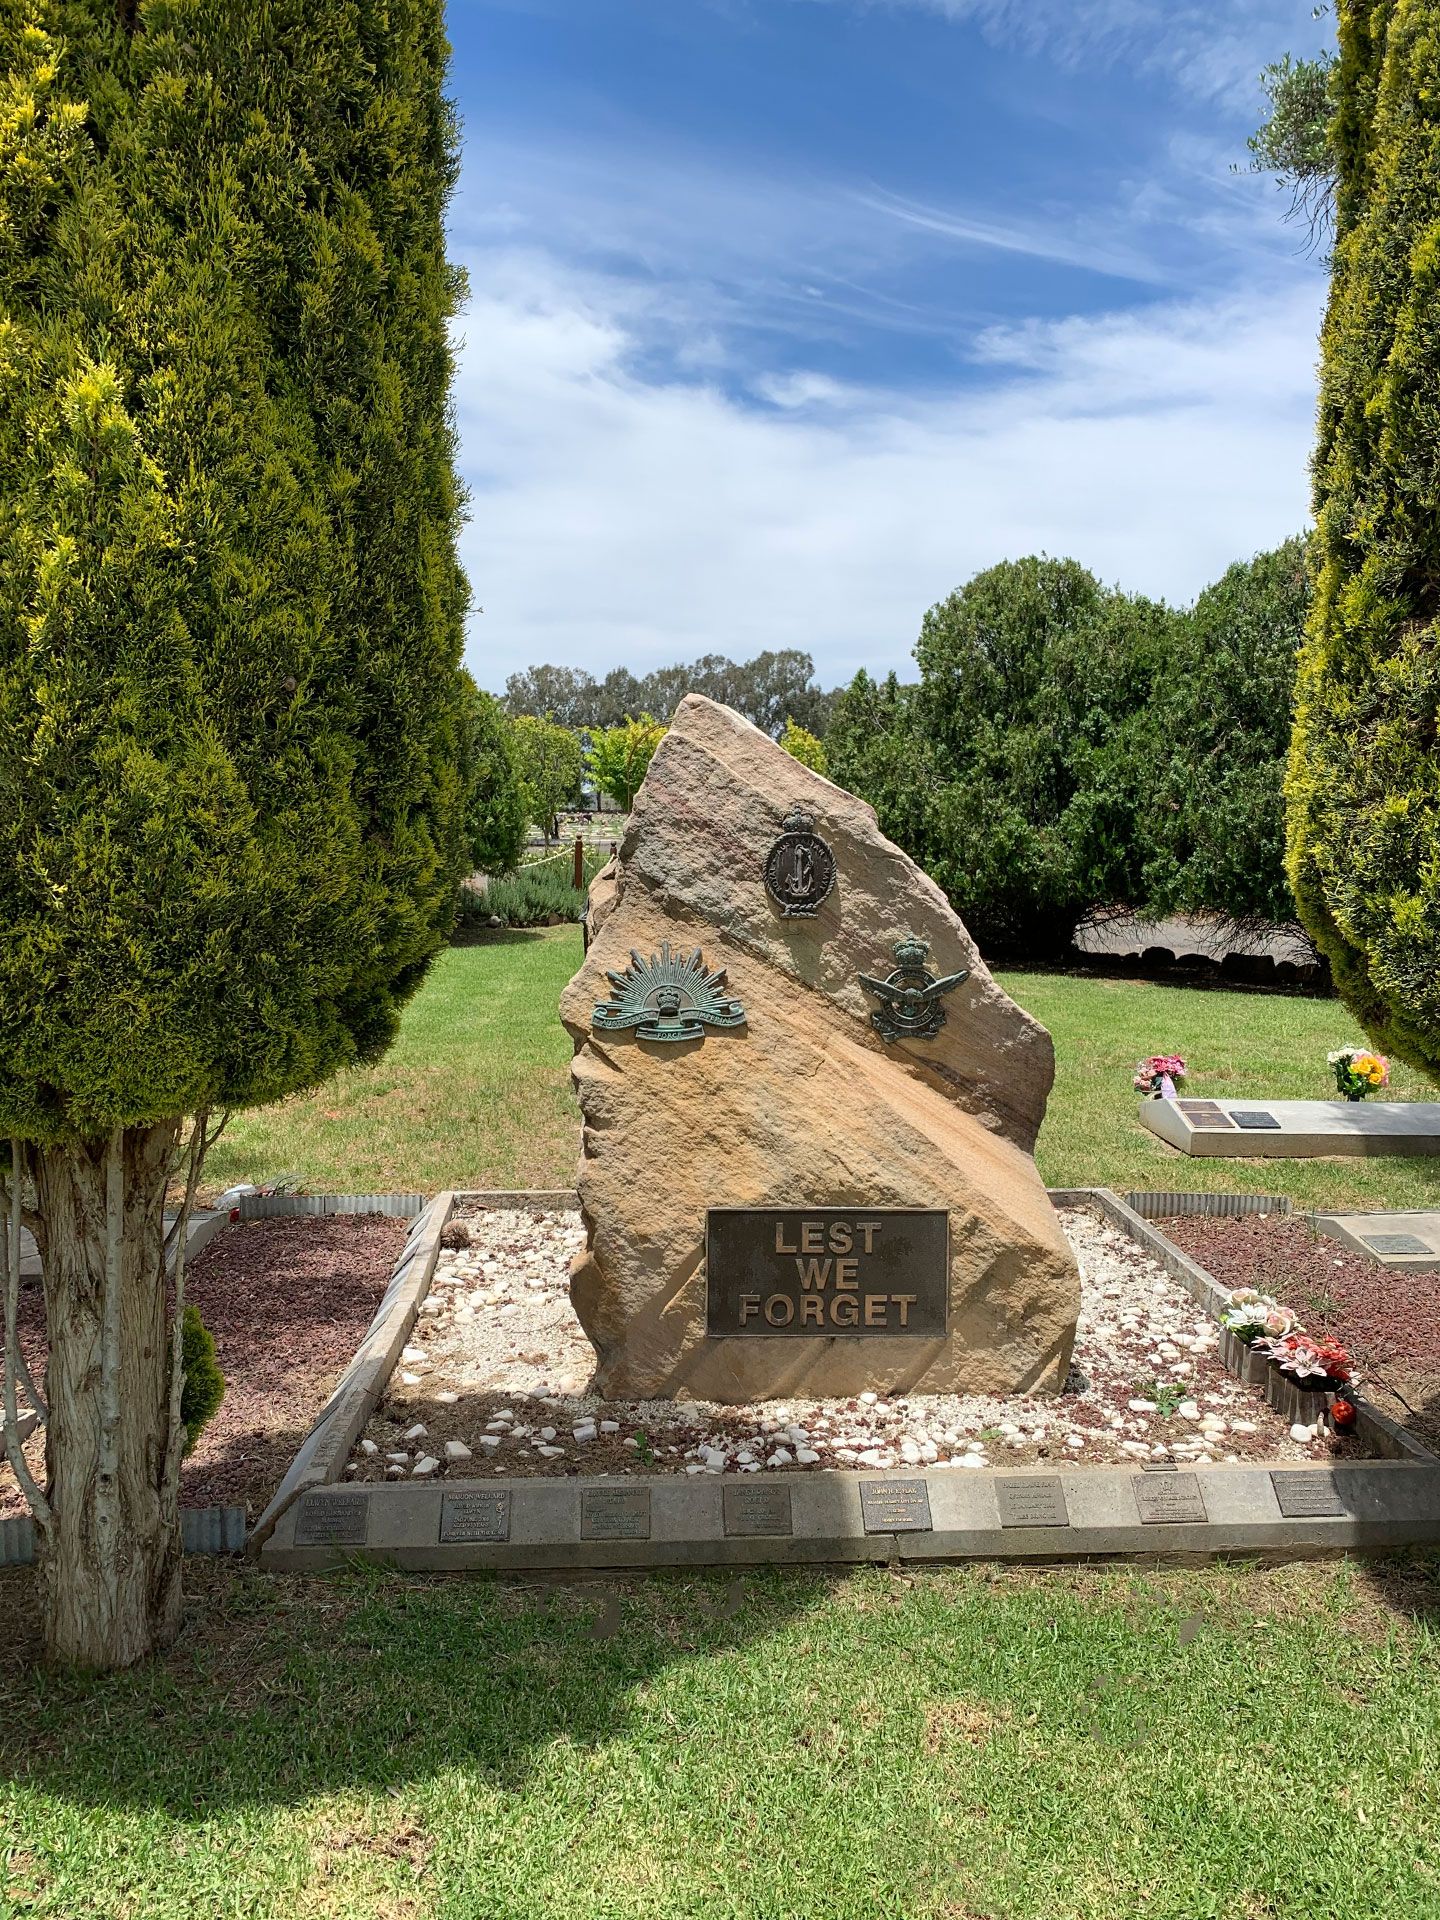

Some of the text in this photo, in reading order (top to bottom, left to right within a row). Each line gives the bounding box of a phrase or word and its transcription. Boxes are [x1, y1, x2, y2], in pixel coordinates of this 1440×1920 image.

[657, 1032, 682, 1040] FORCE
[775, 1221, 882, 1254] LEST
[795, 1258, 859, 1290] WE
[738, 1293, 917, 1327] FORGET
